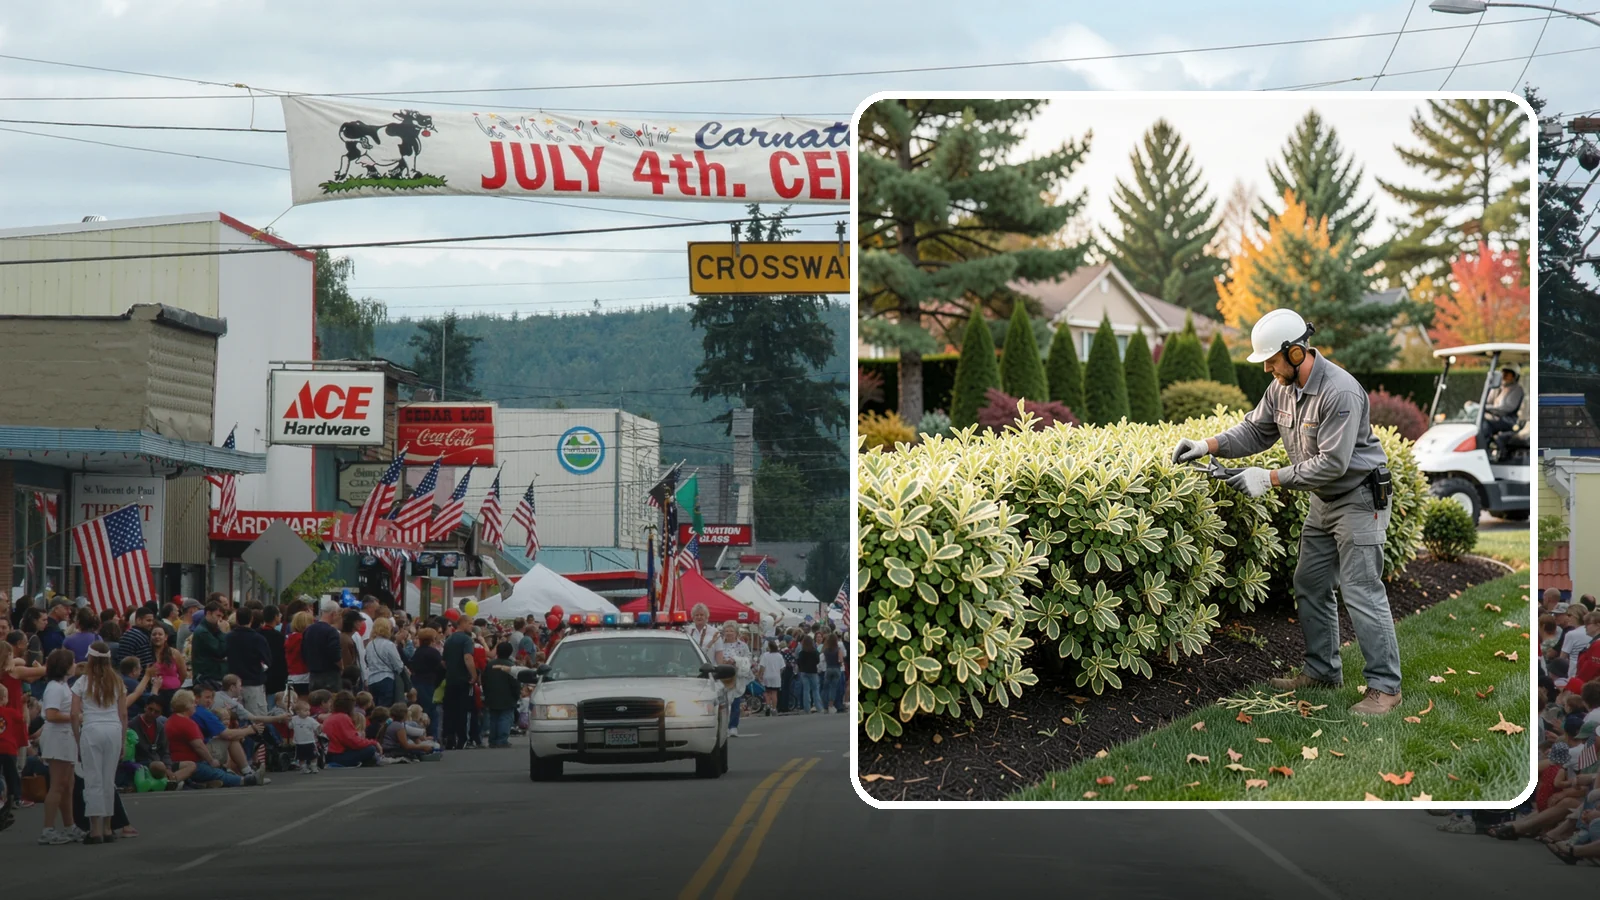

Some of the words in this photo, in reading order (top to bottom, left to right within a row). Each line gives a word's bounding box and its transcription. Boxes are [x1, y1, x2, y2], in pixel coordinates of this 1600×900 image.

[481, 140, 604, 192] JULY
[632, 150, 746, 197] 4th.
[697, 255, 850, 280] CROSSWA
[283, 380, 373, 420] ACE
[406, 410, 452, 421] CEDAR
[461, 409, 485, 421] LOG
[283, 421, 371, 436] Hardware
[416, 428, 477, 447] Coca-Cola
[83, 486, 93, 494] St.
[96, 485, 124, 495] Vincent
[126, 486, 135, 495] de
[138, 486, 155, 495] Paul
[688, 526, 742, 535] CRNATION
[699, 535, 730, 543] GLASS
